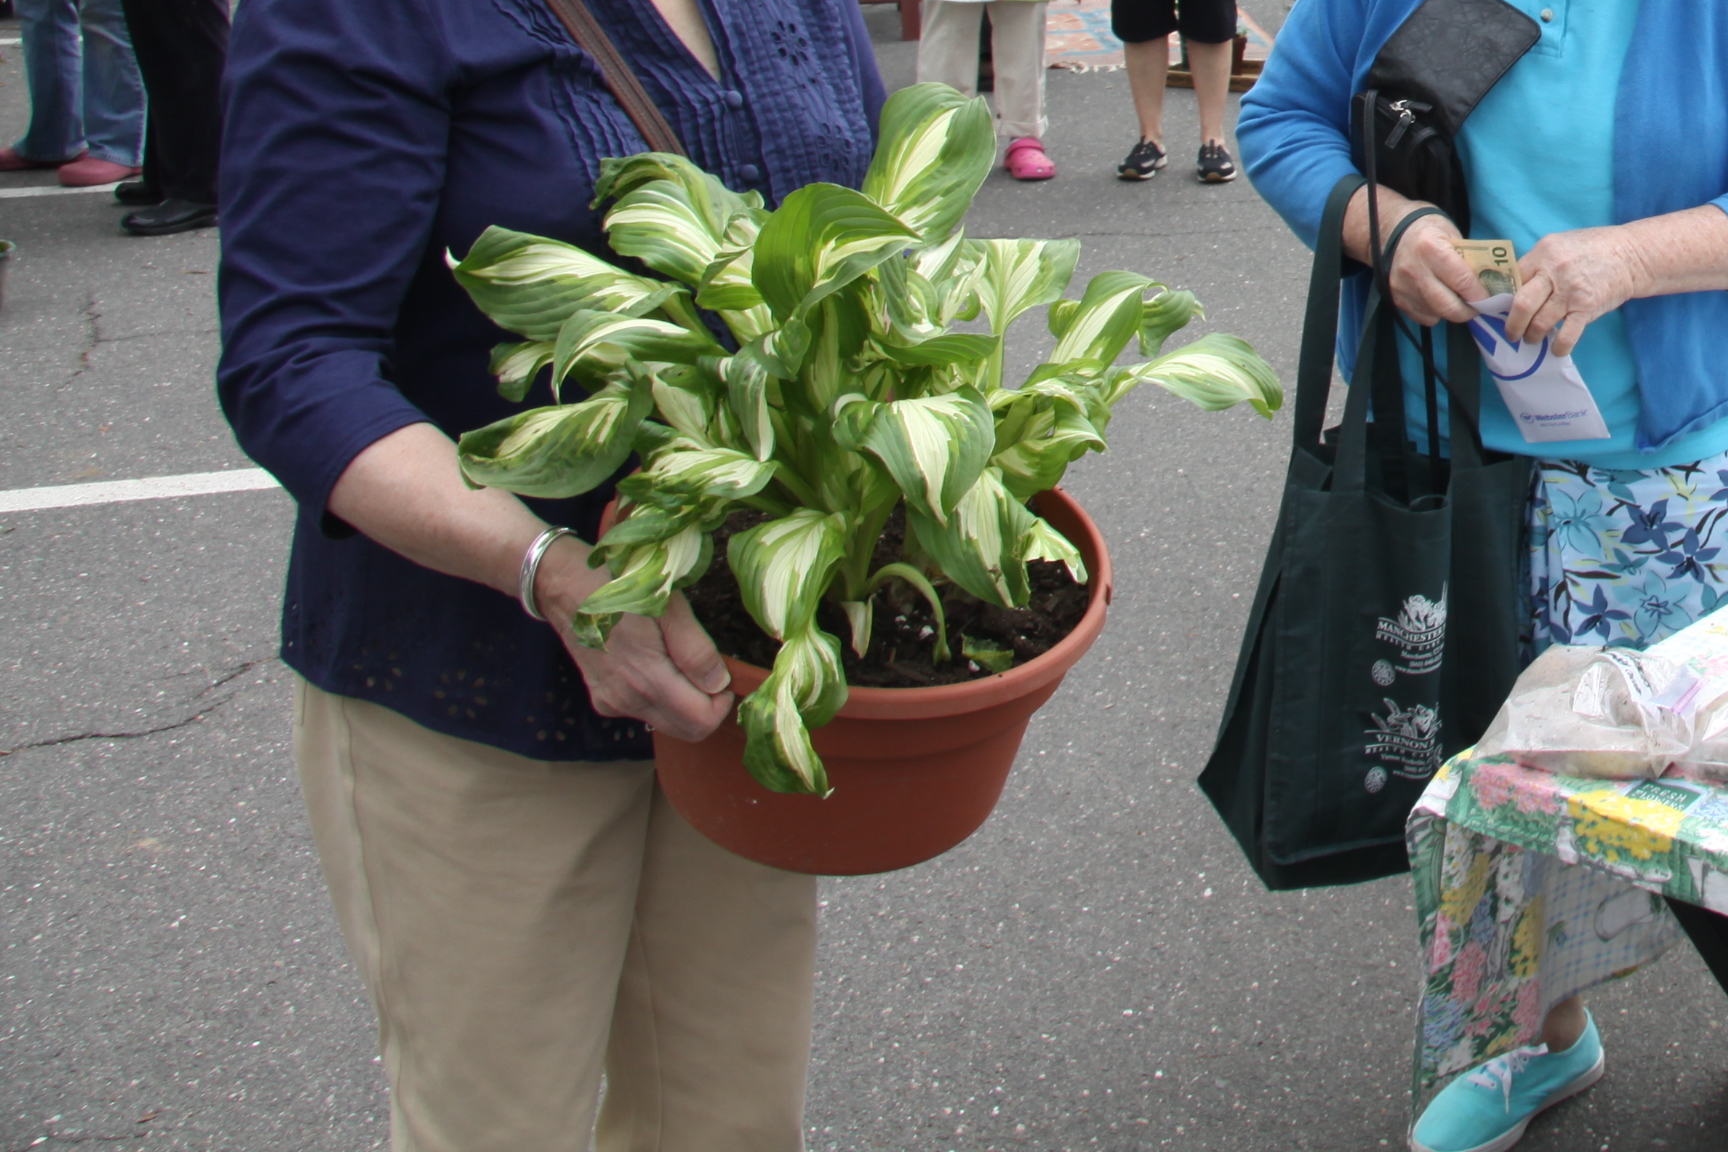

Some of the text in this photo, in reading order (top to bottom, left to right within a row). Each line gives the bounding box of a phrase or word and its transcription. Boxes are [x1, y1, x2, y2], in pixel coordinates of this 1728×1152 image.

[1492, 246, 1508, 266] 10
[1376, 734, 1428, 749] VERNON
[1642, 783, 1688, 803] FRESH
